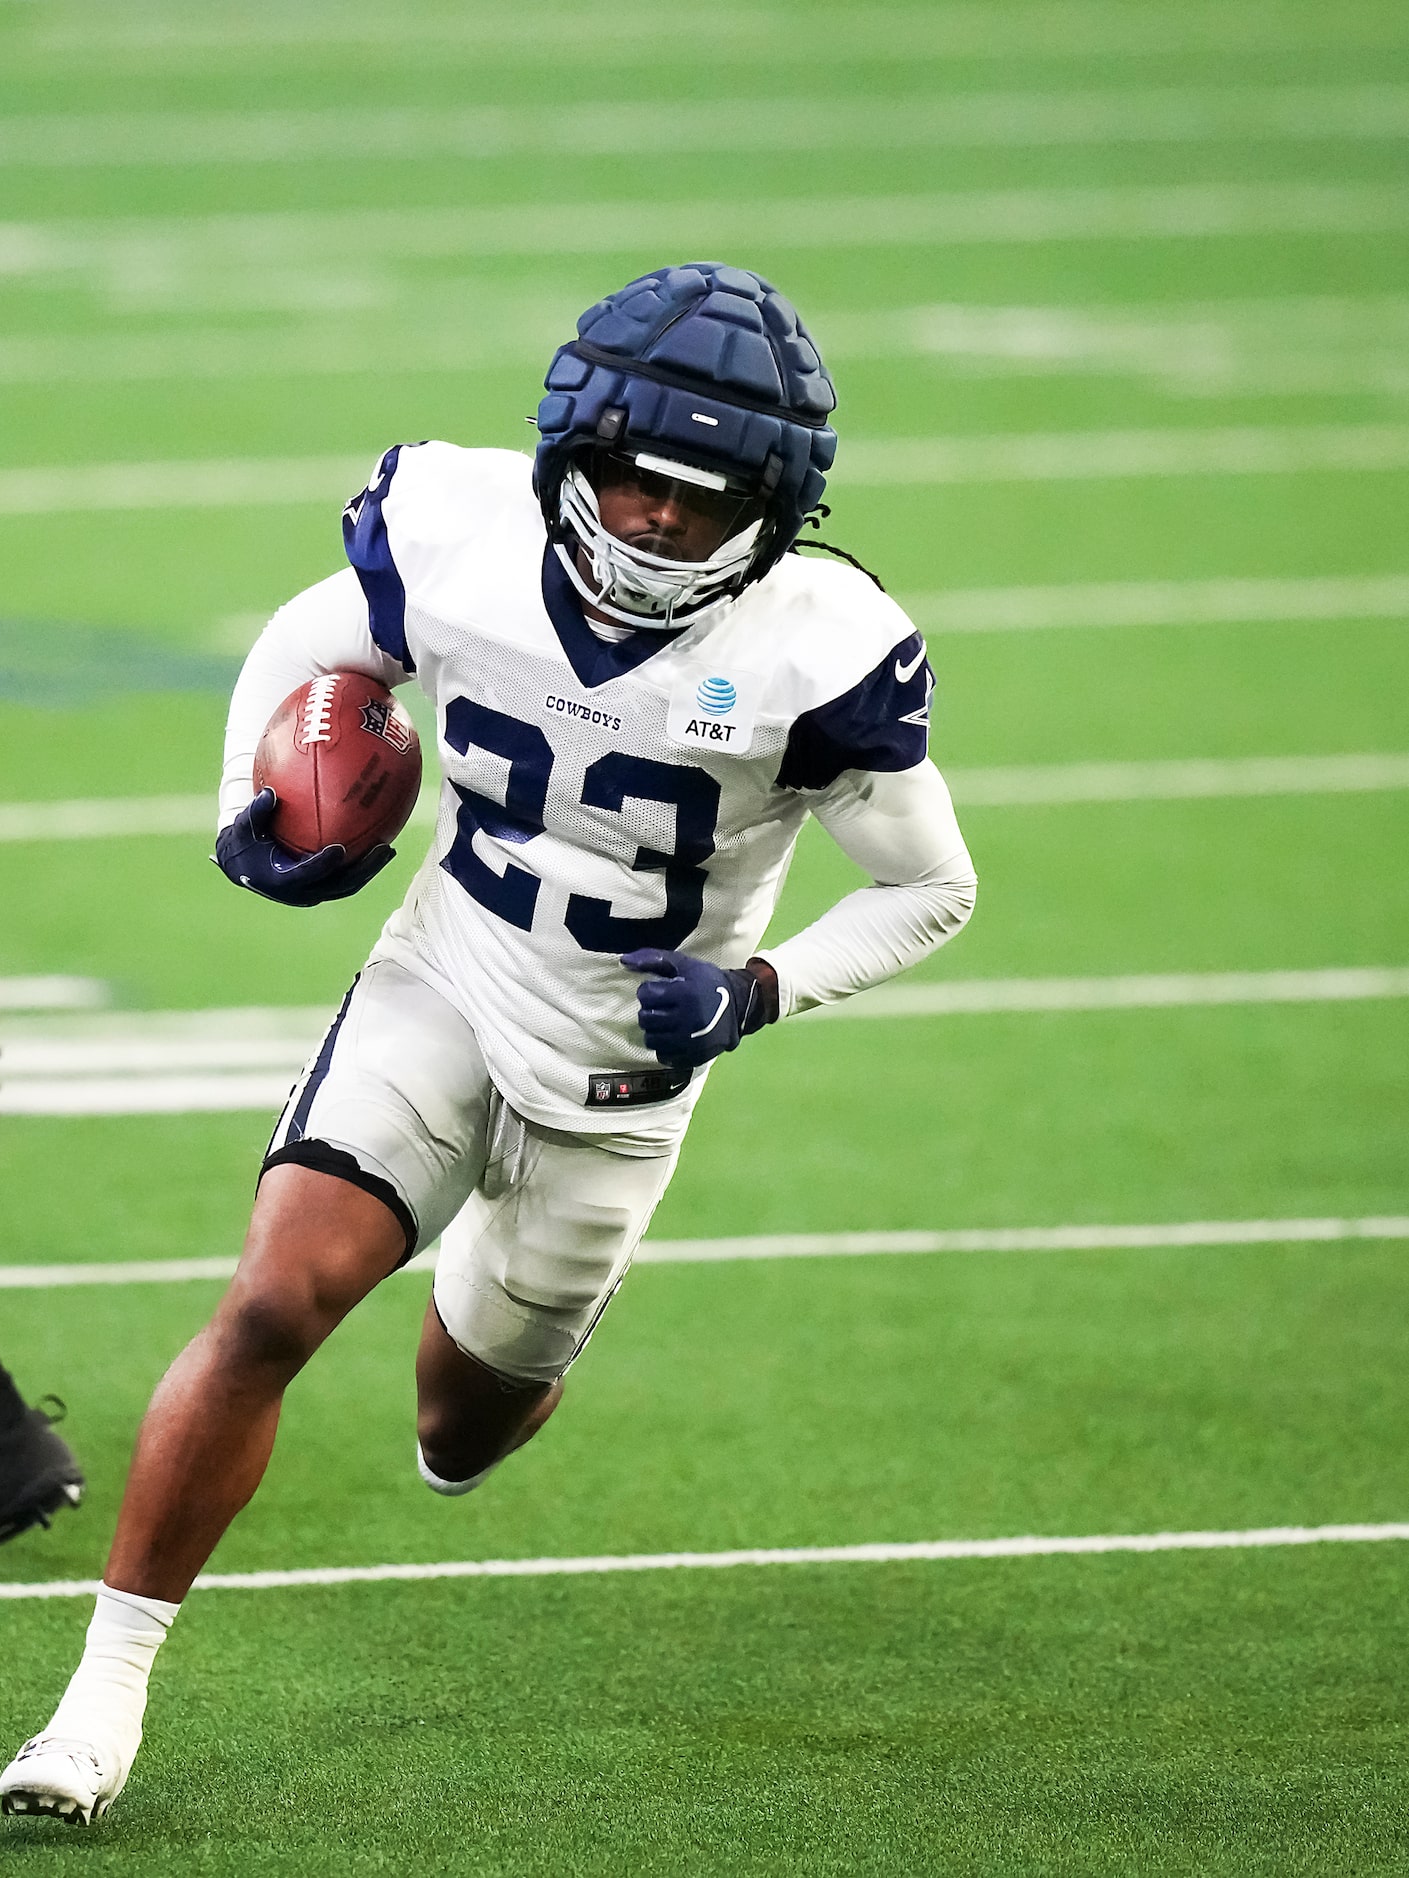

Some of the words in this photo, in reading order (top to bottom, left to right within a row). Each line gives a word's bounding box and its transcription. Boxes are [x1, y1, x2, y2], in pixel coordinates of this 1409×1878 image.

[545, 695, 622, 731] COWBOYS
[685, 719, 736, 742] AT&T
[439, 695, 722, 955] 23
